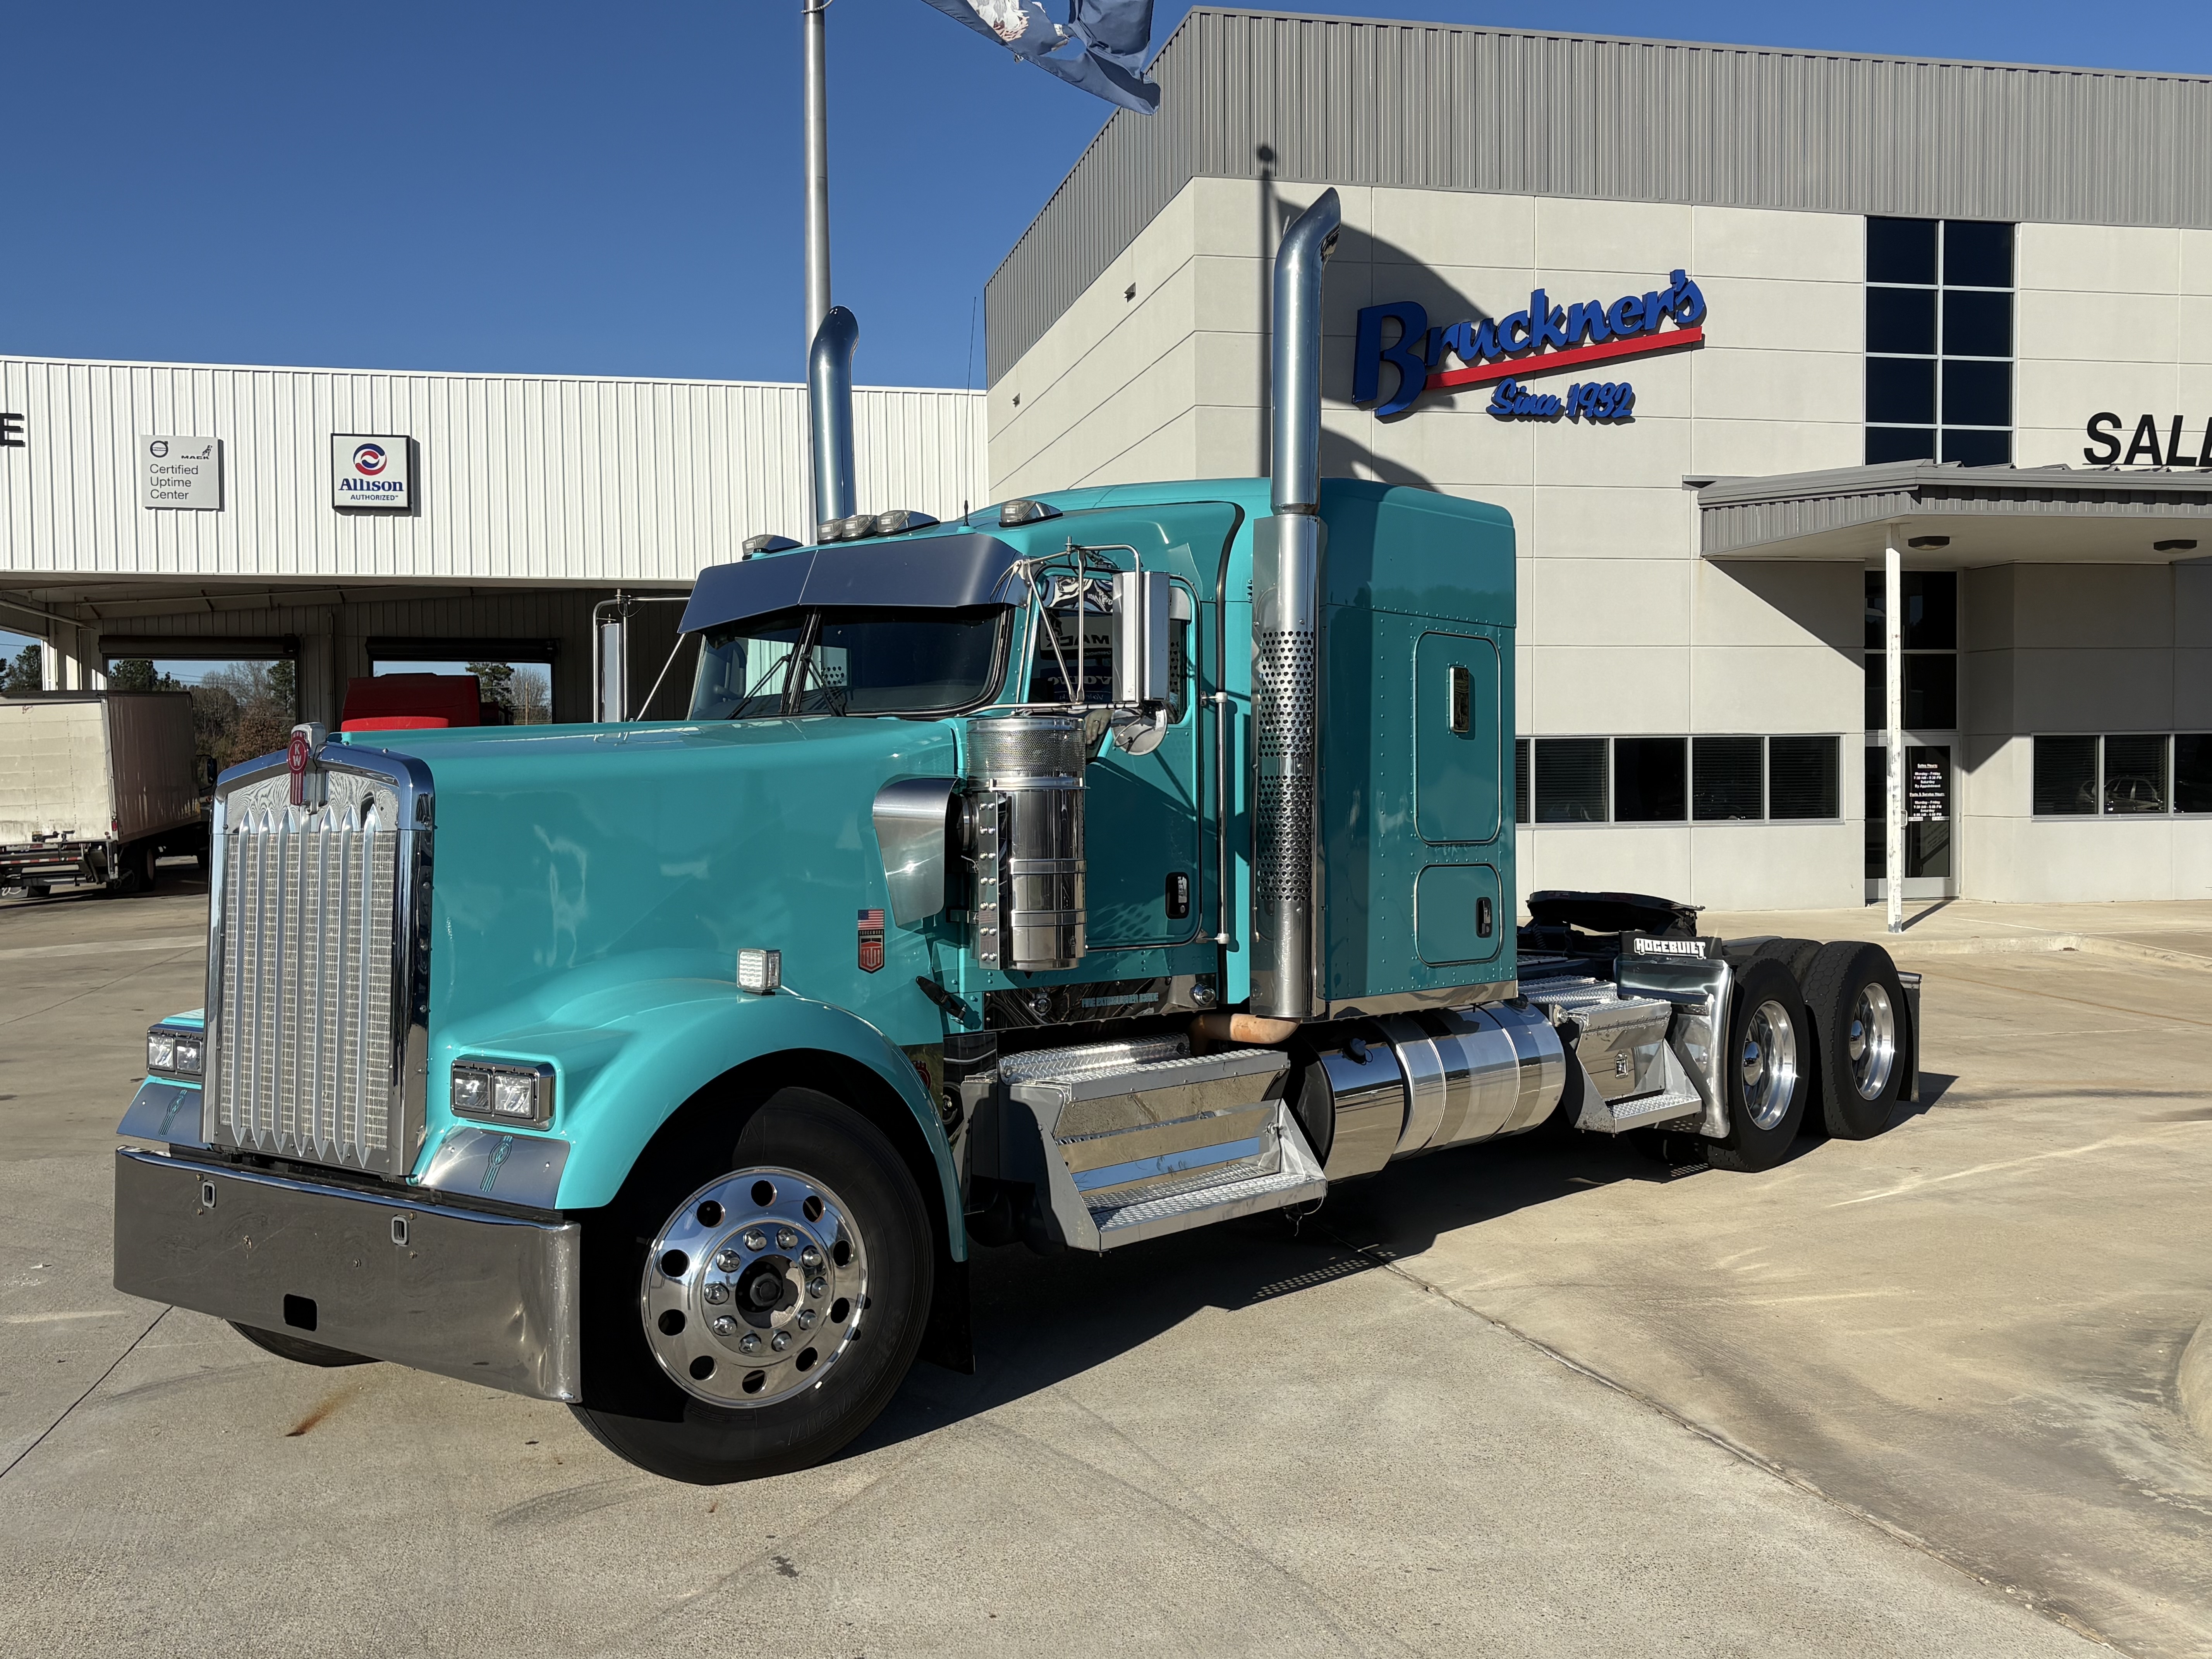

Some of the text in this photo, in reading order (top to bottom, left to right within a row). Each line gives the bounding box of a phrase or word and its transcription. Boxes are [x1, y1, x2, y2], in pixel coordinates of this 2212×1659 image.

[1352, 269, 1705, 415] Bruckner's
[1487, 378, 1633, 418] Since 1932
[150, 464, 198, 474] Certified
[150, 476, 191, 488] Uptime
[338, 478, 404, 491] Allison
[150, 489, 189, 499] Center
[295, 744, 300, 754] K
[293, 755, 301, 766] W
[1634, 938, 1706, 959] HOGEBUILT
